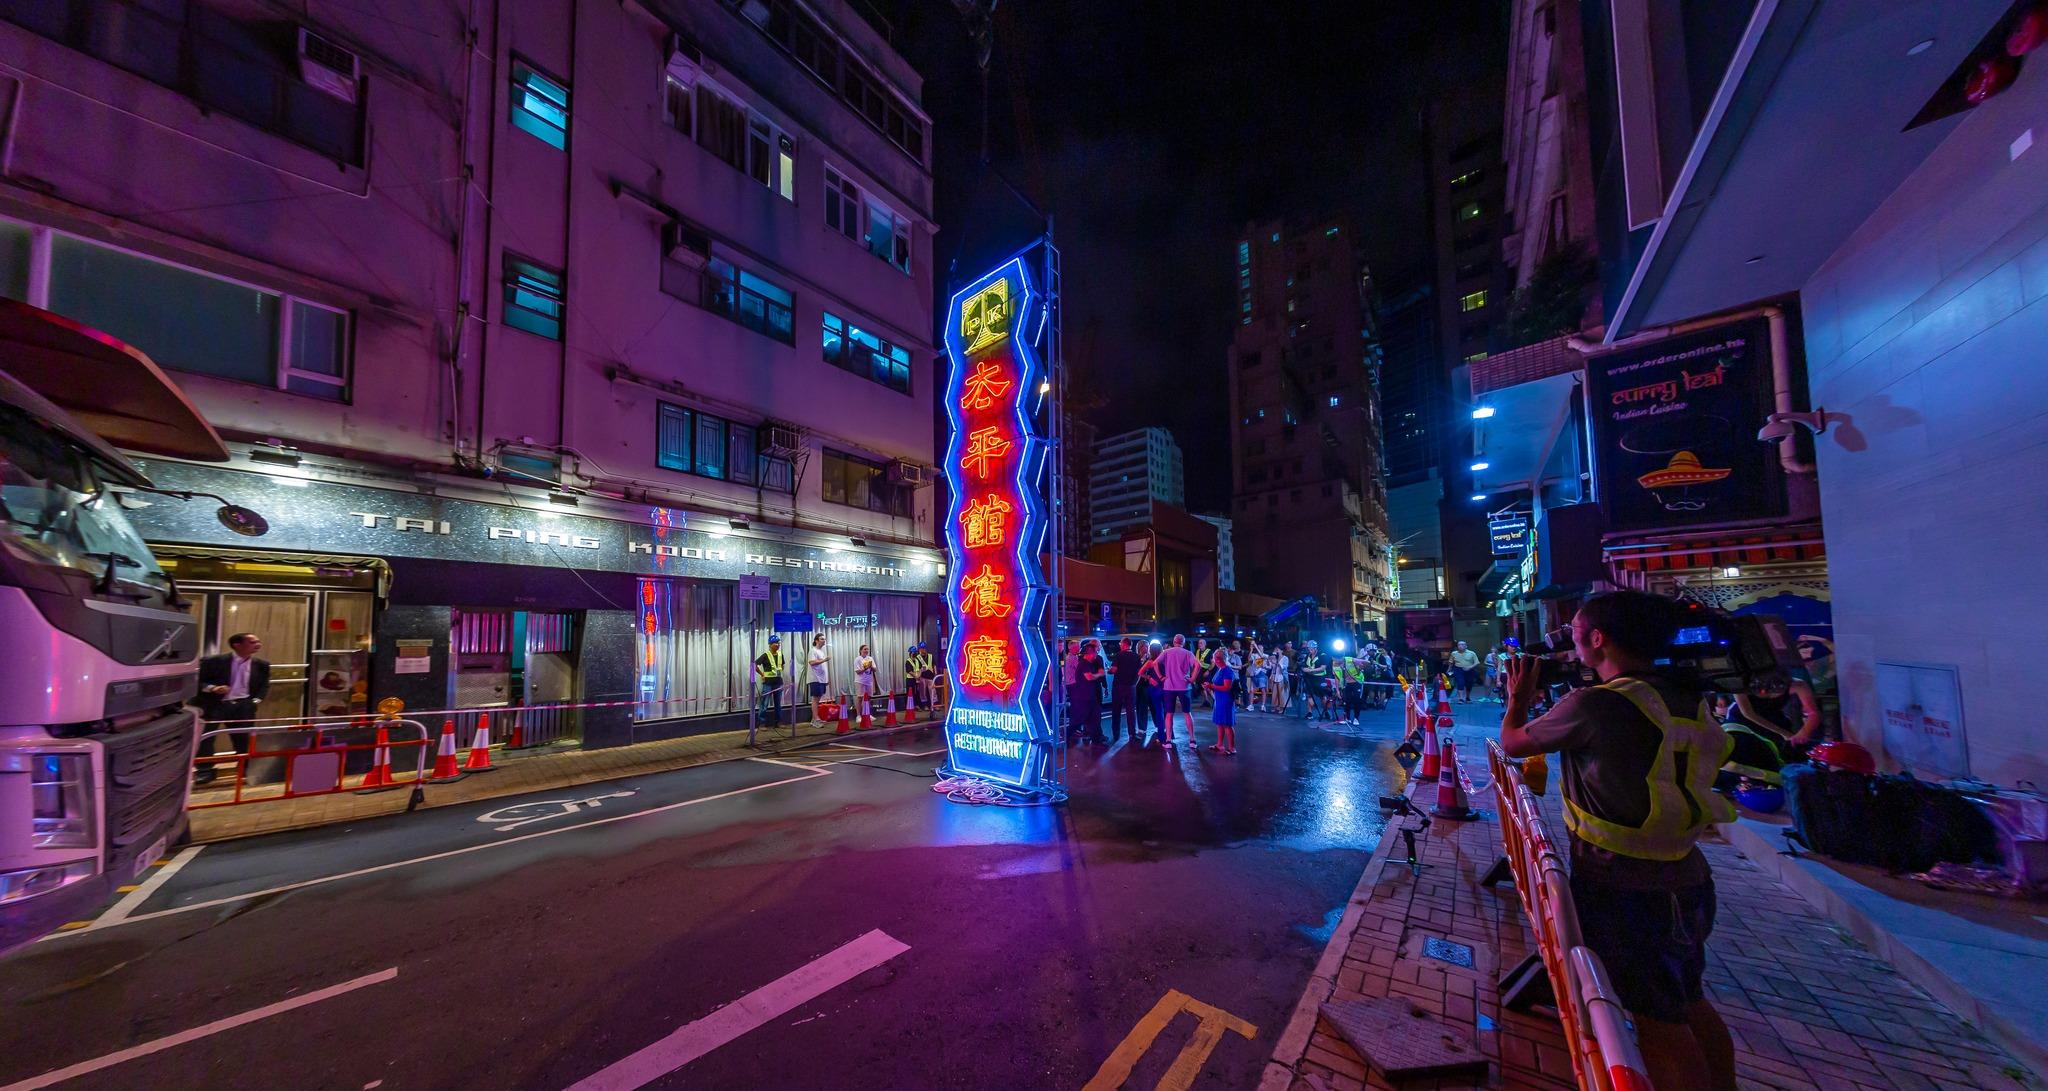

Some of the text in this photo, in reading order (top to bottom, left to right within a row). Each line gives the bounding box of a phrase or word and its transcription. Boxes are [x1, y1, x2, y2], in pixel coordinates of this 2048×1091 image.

[1607, 338, 1746, 375] www.orderonline.hk
[1611, 364, 1725, 405] curry leaf
[1612, 402, 1688, 421] Indian Cuisine
[350, 511, 906, 578] TAI PING KOON RESTAURANT
[787, 588, 802, 609] P
[1103, 604, 1110, 617] P
[954, 733, 1023, 759] RESTAURANT
